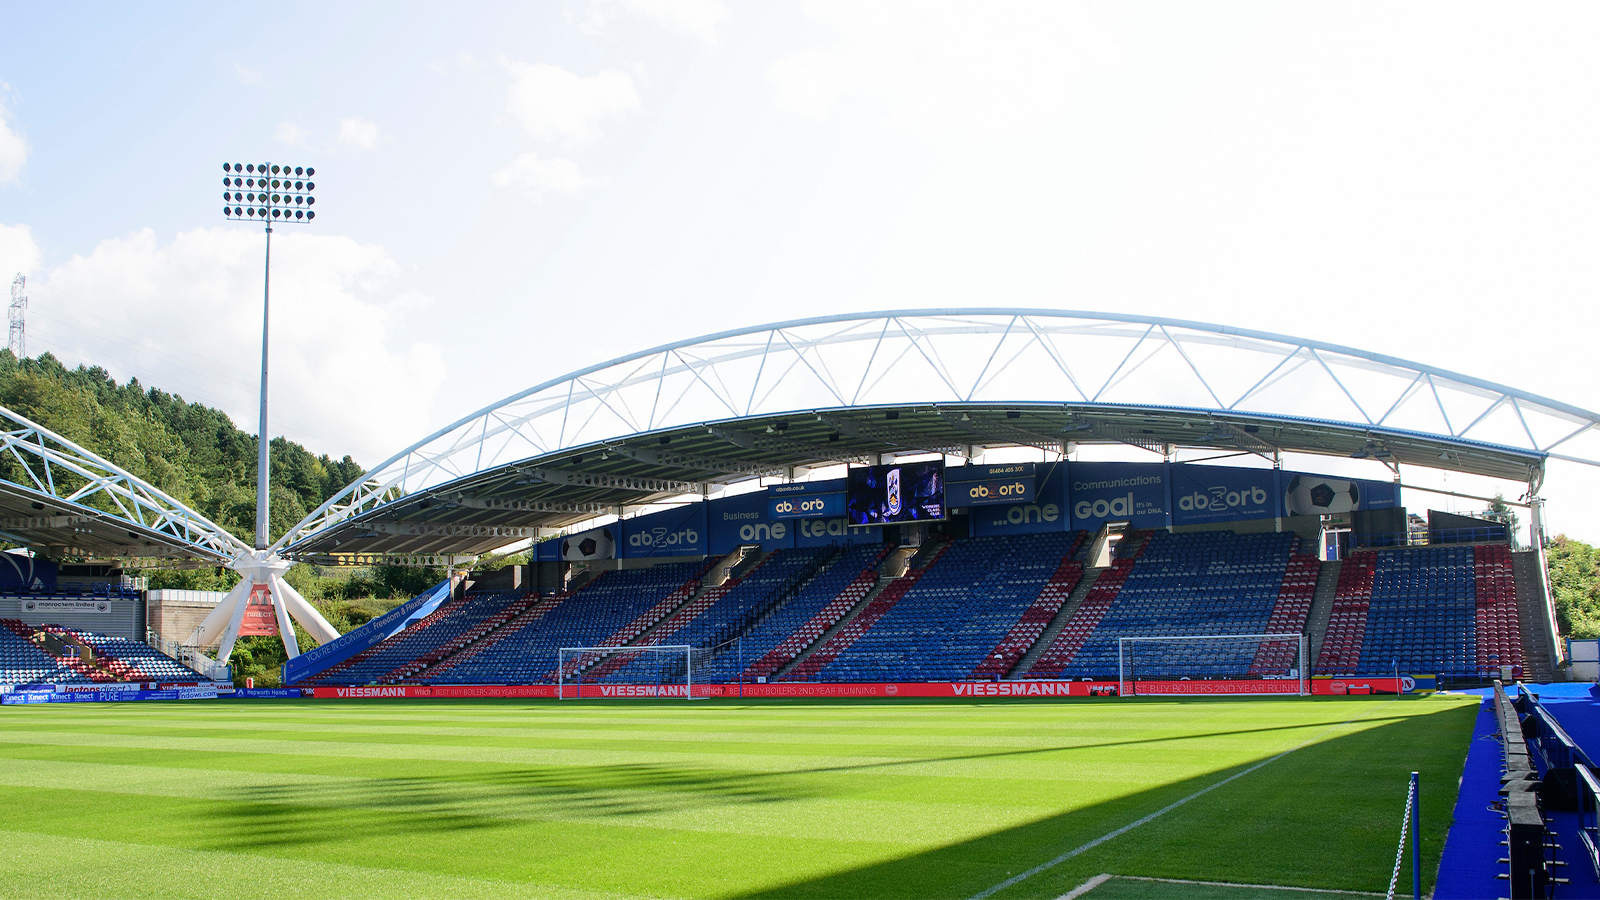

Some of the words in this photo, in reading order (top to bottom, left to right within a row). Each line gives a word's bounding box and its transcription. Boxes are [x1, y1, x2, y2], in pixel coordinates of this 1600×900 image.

[1074, 475, 1161, 491] Communications
[723, 511, 759, 521] Business
[739, 522, 786, 541] one
[373, 611, 401, 630] Freedom
[400, 607, 406, 616] &
[305, 645, 331, 662] YOU'RE
[330, 641, 339, 652] IN
[339, 626, 372, 648] CONTROL
[99, 691, 119, 701] PURE
[337, 687, 405, 697] VIESSMANN
[414, 688, 433, 696] Which?
[435, 688, 450, 696] BEST
[451, 688, 463, 696] BUY
[463, 688, 487, 696] BOILERS
[488, 688, 500, 696] 2ND
[501, 688, 516, 696] YEAR
[516, 688, 547, 696] RUNNING
[600, 686, 688, 696] VIESSMANN
[701, 687, 726, 695] Which?
[729, 687, 748, 695] BEST
[749, 687, 765, 695] BUY
[765, 687, 797, 695] BOILERS
[798, 687, 814, 695] 2ND
[814, 687, 836, 695] YEAR
[837, 687, 877, 695] RUNNING
[951, 683, 1070, 696] VIESSMANN
[1123, 684, 1147, 694] BEST
[1150, 684, 1171, 694] BUY
[1172, 684, 1213, 694] BOILERS
[1214, 684, 1235, 694] 2ND
[1237, 684, 1265, 694] YEAR
[1267, 684, 1318, 694] RUNNNG
